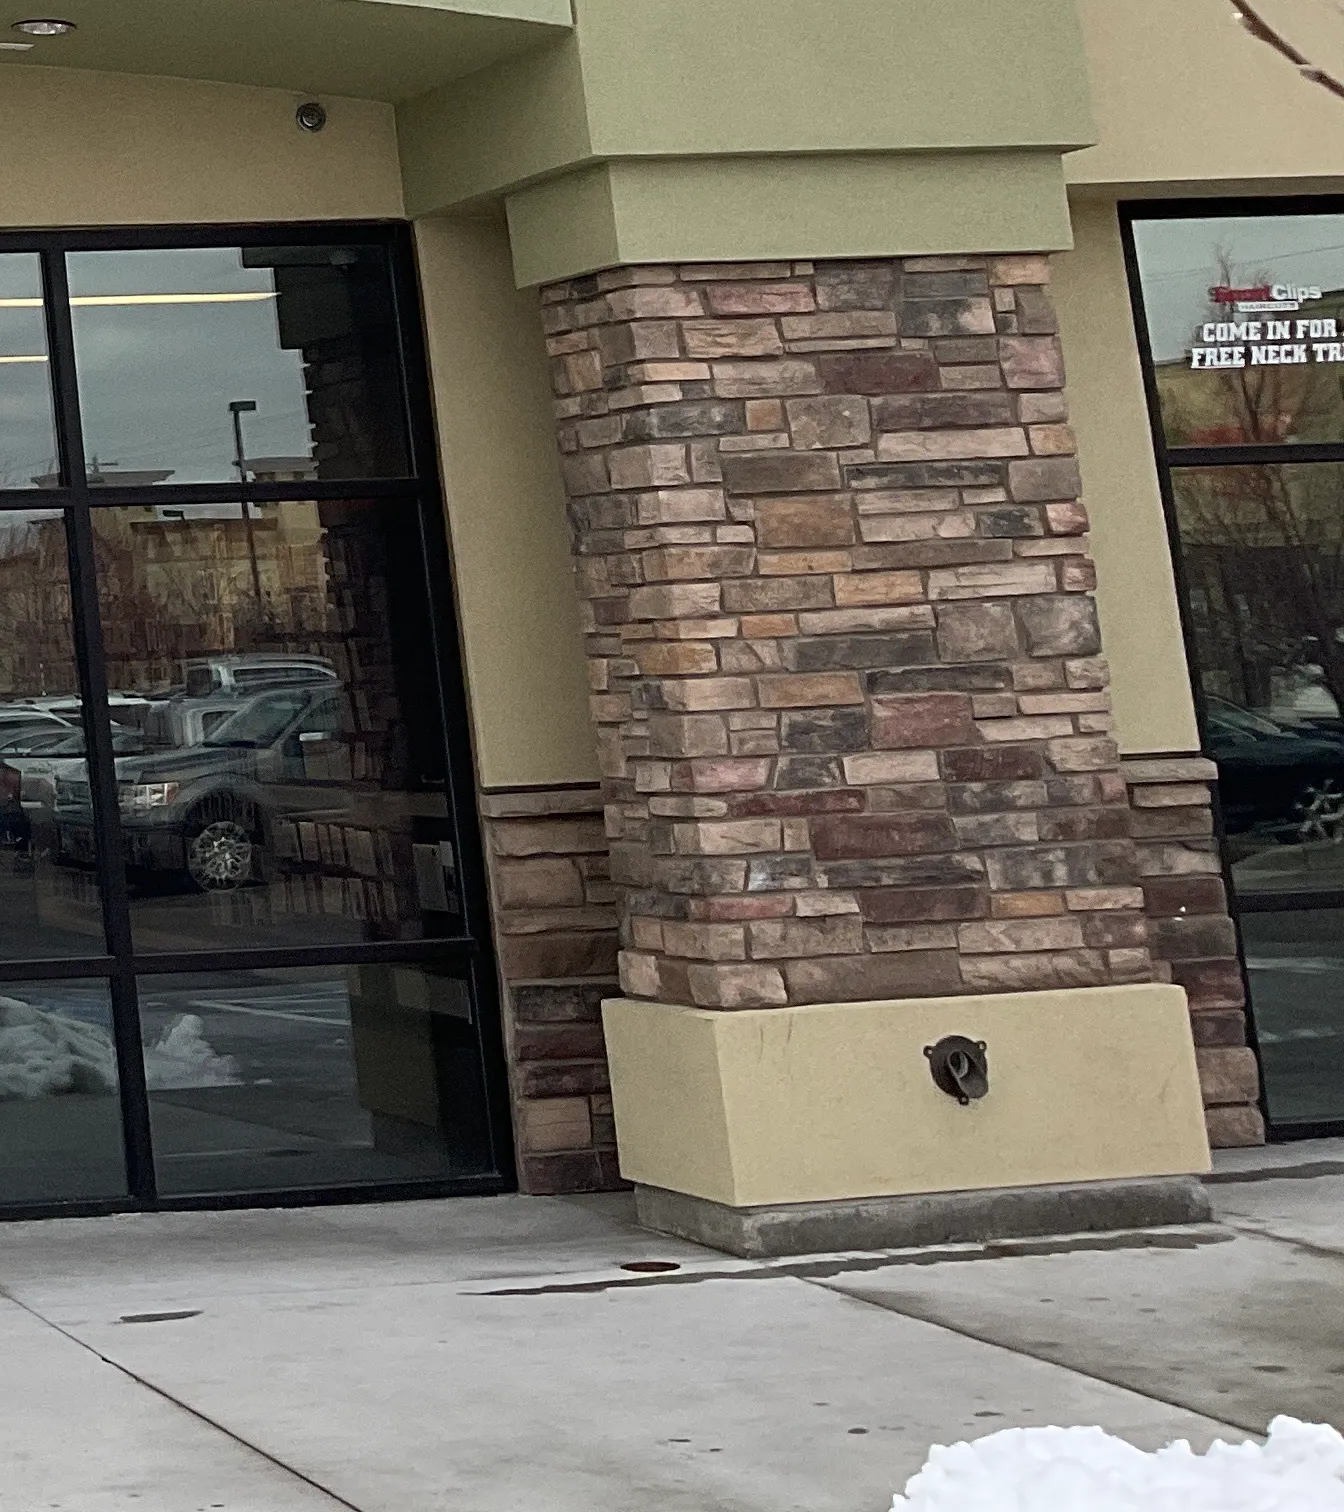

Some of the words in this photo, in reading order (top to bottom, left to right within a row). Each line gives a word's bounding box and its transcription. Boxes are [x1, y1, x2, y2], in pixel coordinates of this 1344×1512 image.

[1271, 284, 1323, 304] Clips
[1203, 321, 1262, 342] COME
[1267, 320, 1291, 340] IN
[1296, 319, 1338, 338] FOR
[1191, 346, 1246, 368] FREE
[1251, 343, 1308, 365] NECK
